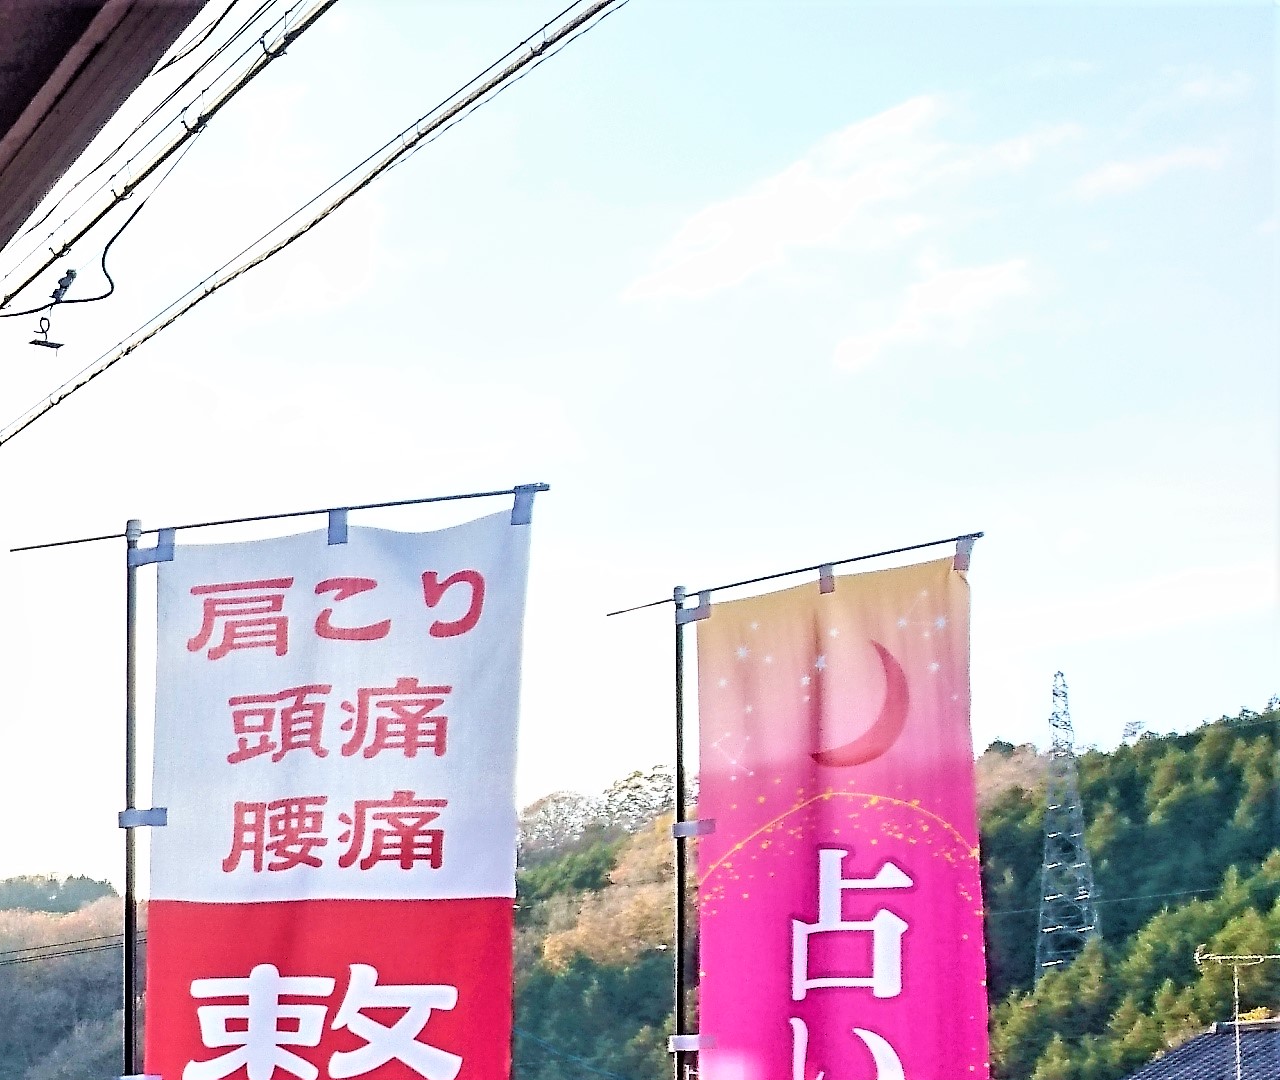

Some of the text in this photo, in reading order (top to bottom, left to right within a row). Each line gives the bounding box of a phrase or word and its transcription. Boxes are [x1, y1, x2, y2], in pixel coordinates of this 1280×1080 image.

[187, 569, 485, 660] 肩こり
[227, 677, 452, 764] 頭痛
[222, 789, 448, 873] 腰痛
